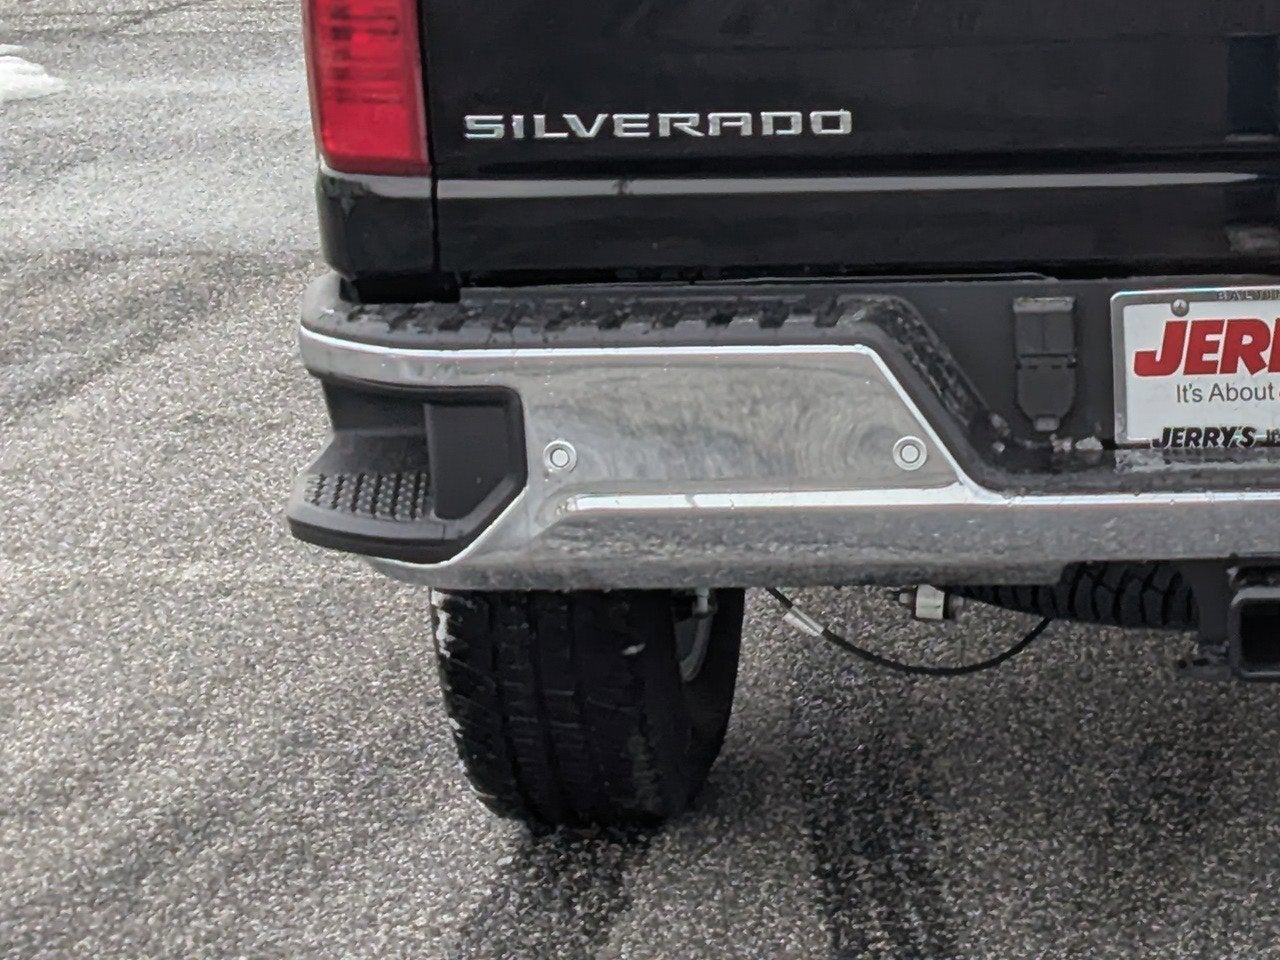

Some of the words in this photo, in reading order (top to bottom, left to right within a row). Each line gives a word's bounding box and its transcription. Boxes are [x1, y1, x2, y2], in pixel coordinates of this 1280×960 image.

[464, 109, 853, 139] SILVERADO
[1176, 383, 1203, 404] It's
[1208, 382, 1275, 403] About
[1152, 426, 1257, 448] JERRY'S
